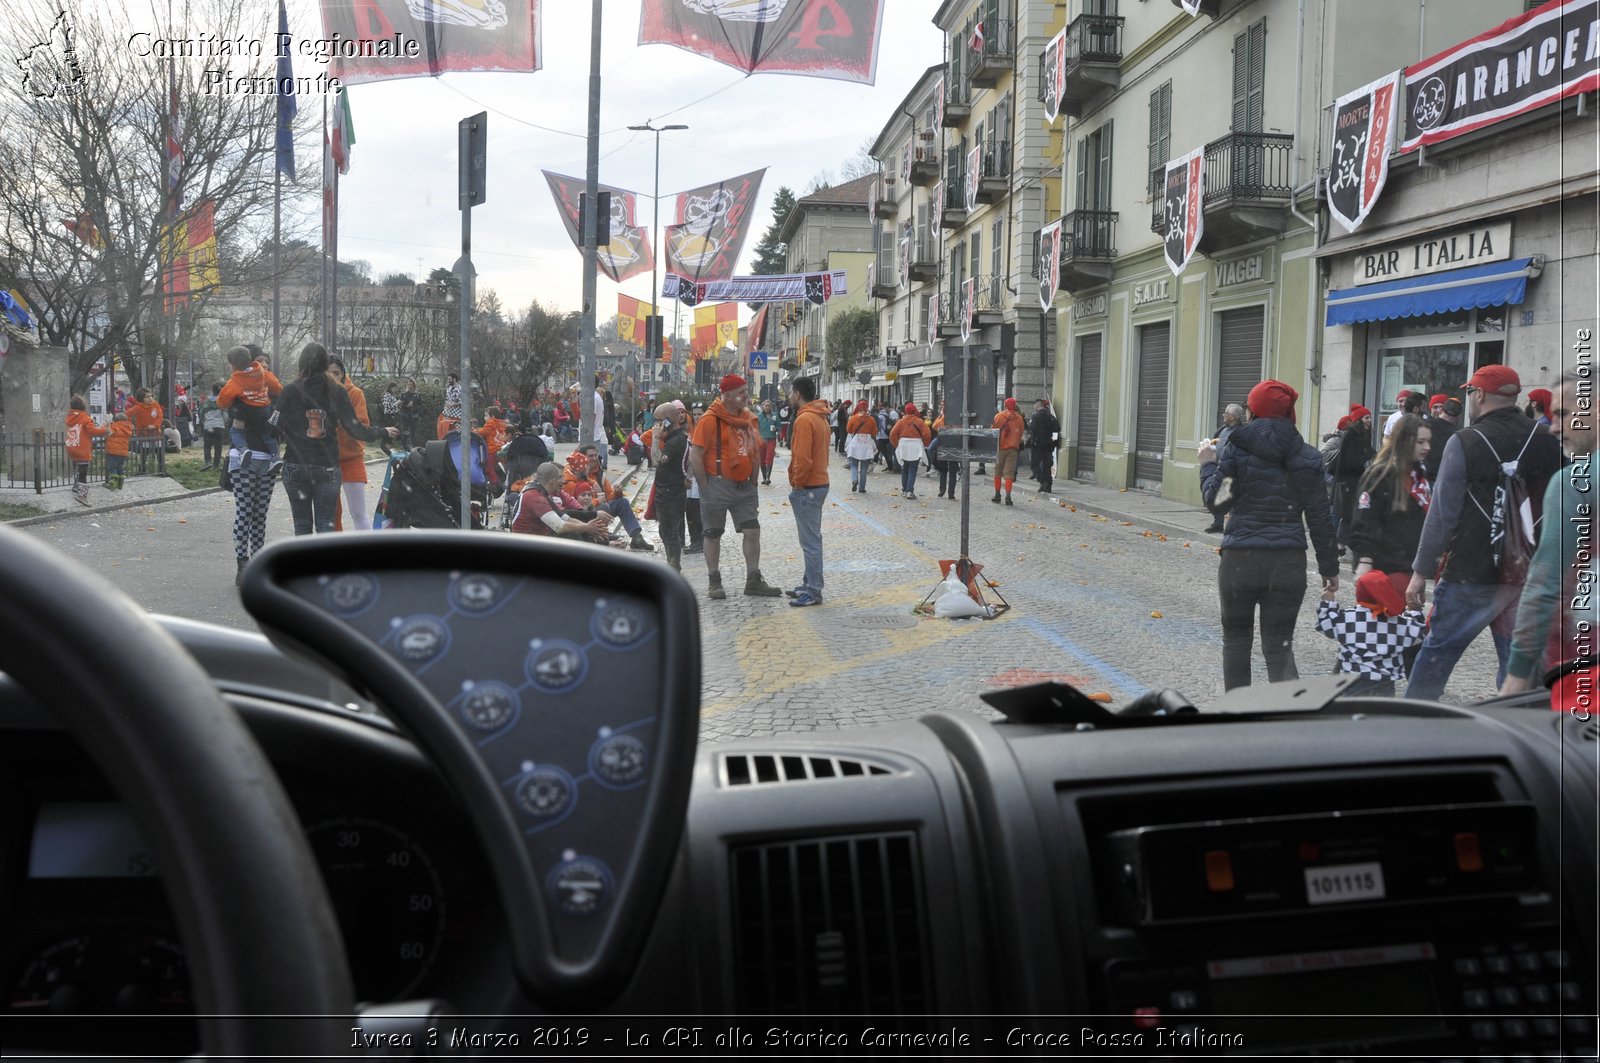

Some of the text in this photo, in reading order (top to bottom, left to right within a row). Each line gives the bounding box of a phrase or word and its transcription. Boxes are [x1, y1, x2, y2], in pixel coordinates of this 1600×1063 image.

[1337, 104, 1369, 130] MORTE
[1369, 92, 1387, 182] 1954
[1168, 170, 1186, 189] MORTE
[1189, 162, 1197, 237] 1954
[1365, 230, 1493, 278] BAR ITALIA
[1214, 255, 1263, 287] VIAGGI
[1072, 295, 1105, 320] TURISMO
[336, 830, 360, 848] 30
[386, 850, 411, 868] 40
[1311, 873, 1375, 895] 101115
[408, 894, 433, 912] 50
[400, 942, 424, 960] 60
